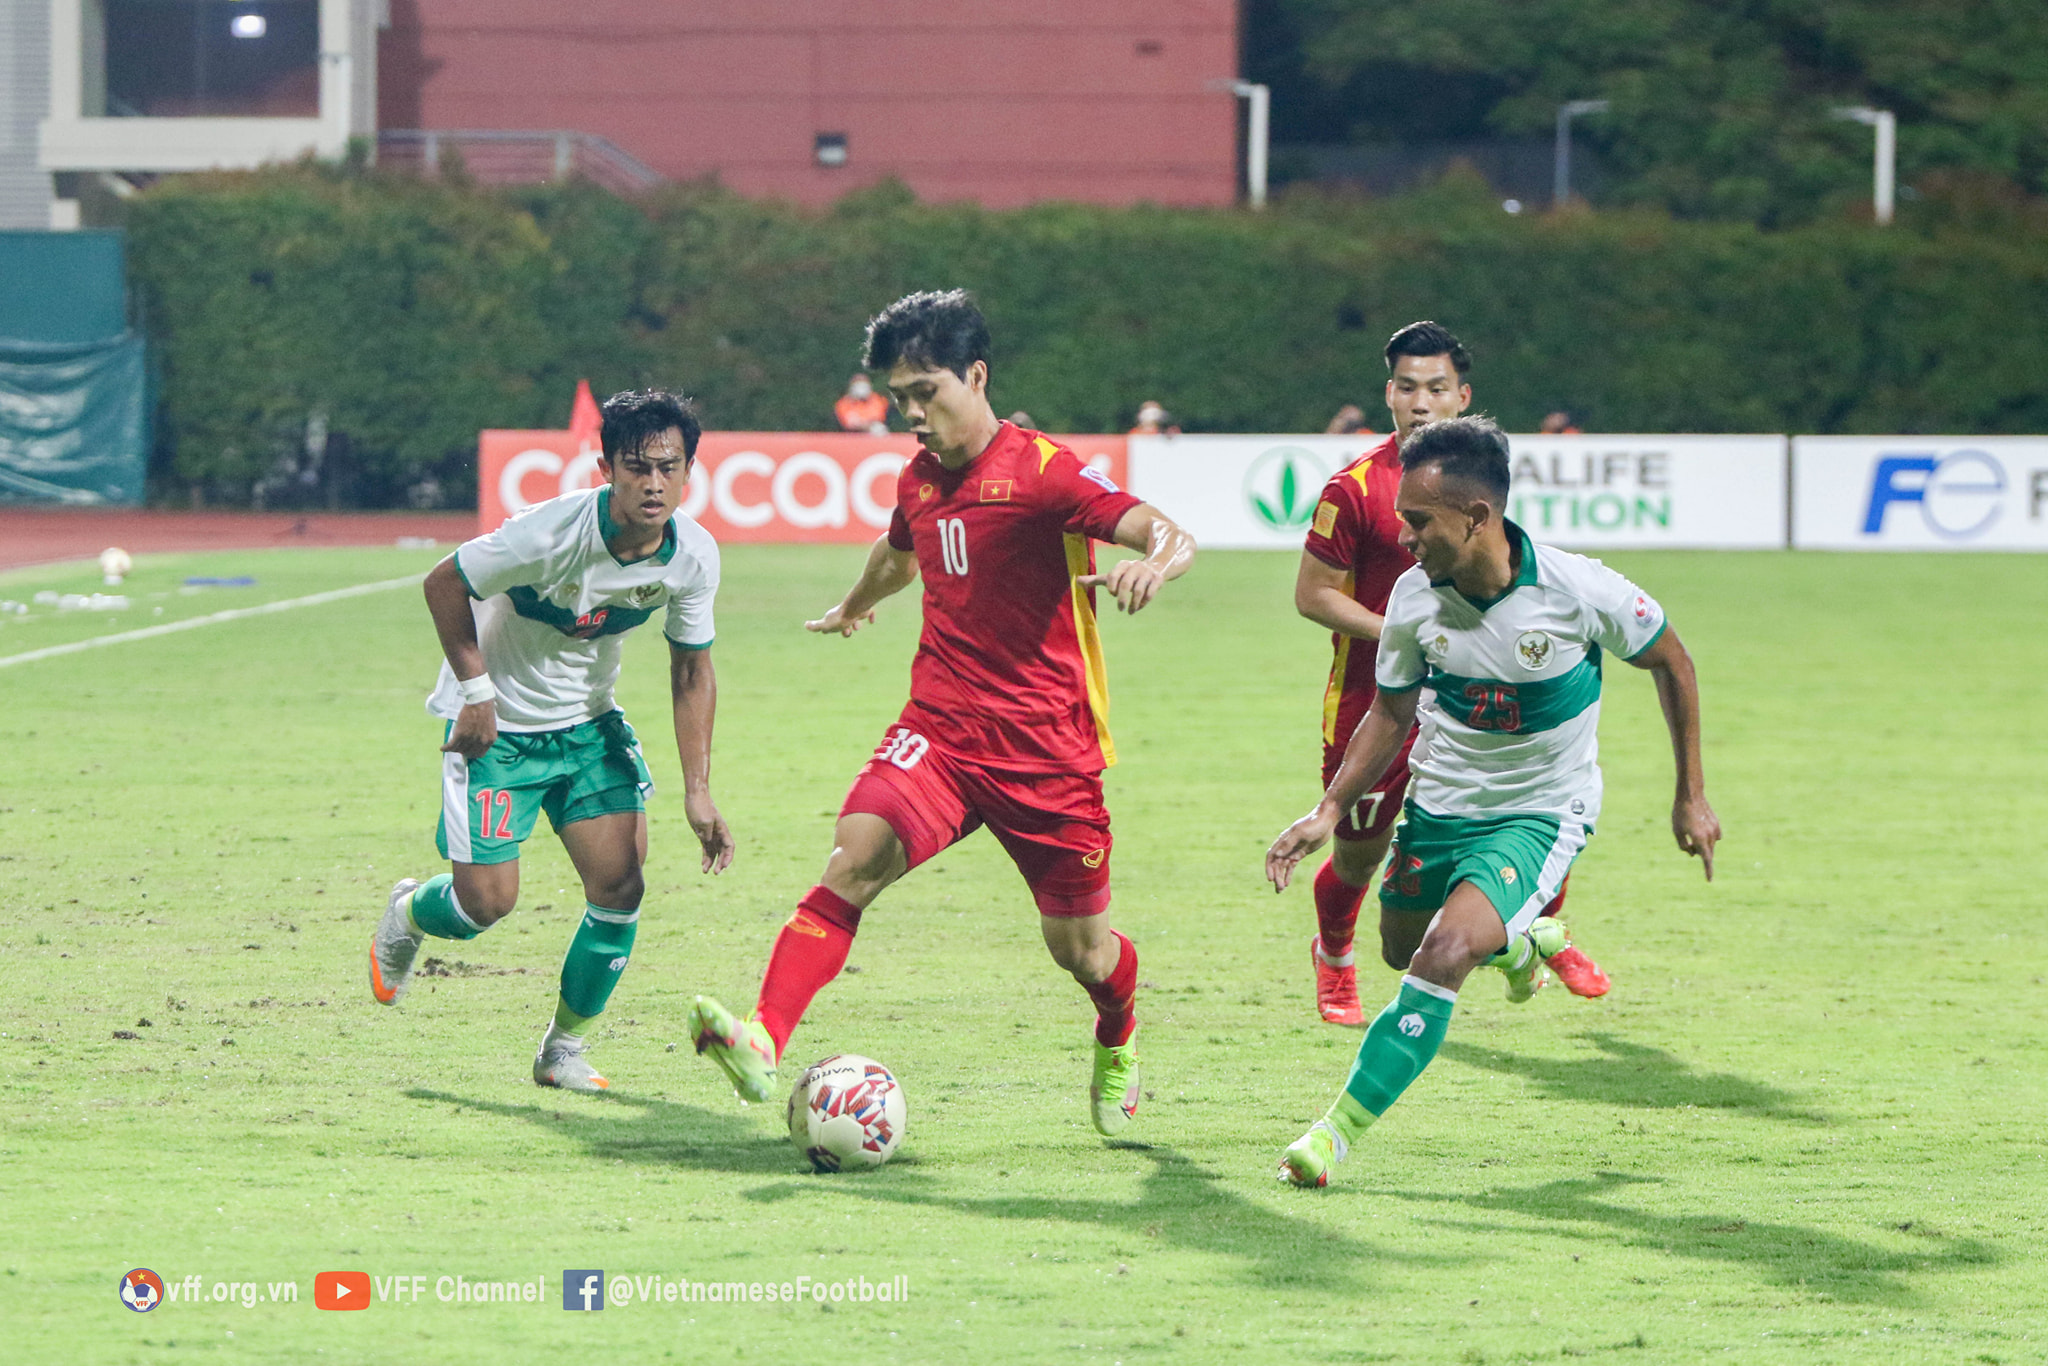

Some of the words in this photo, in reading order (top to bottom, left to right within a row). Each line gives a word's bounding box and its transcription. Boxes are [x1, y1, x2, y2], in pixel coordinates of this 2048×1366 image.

[937, 517, 969, 575] 10
[1464, 684, 1521, 731] 25
[475, 787, 513, 839] 12
[1350, 791, 1386, 831] 17
